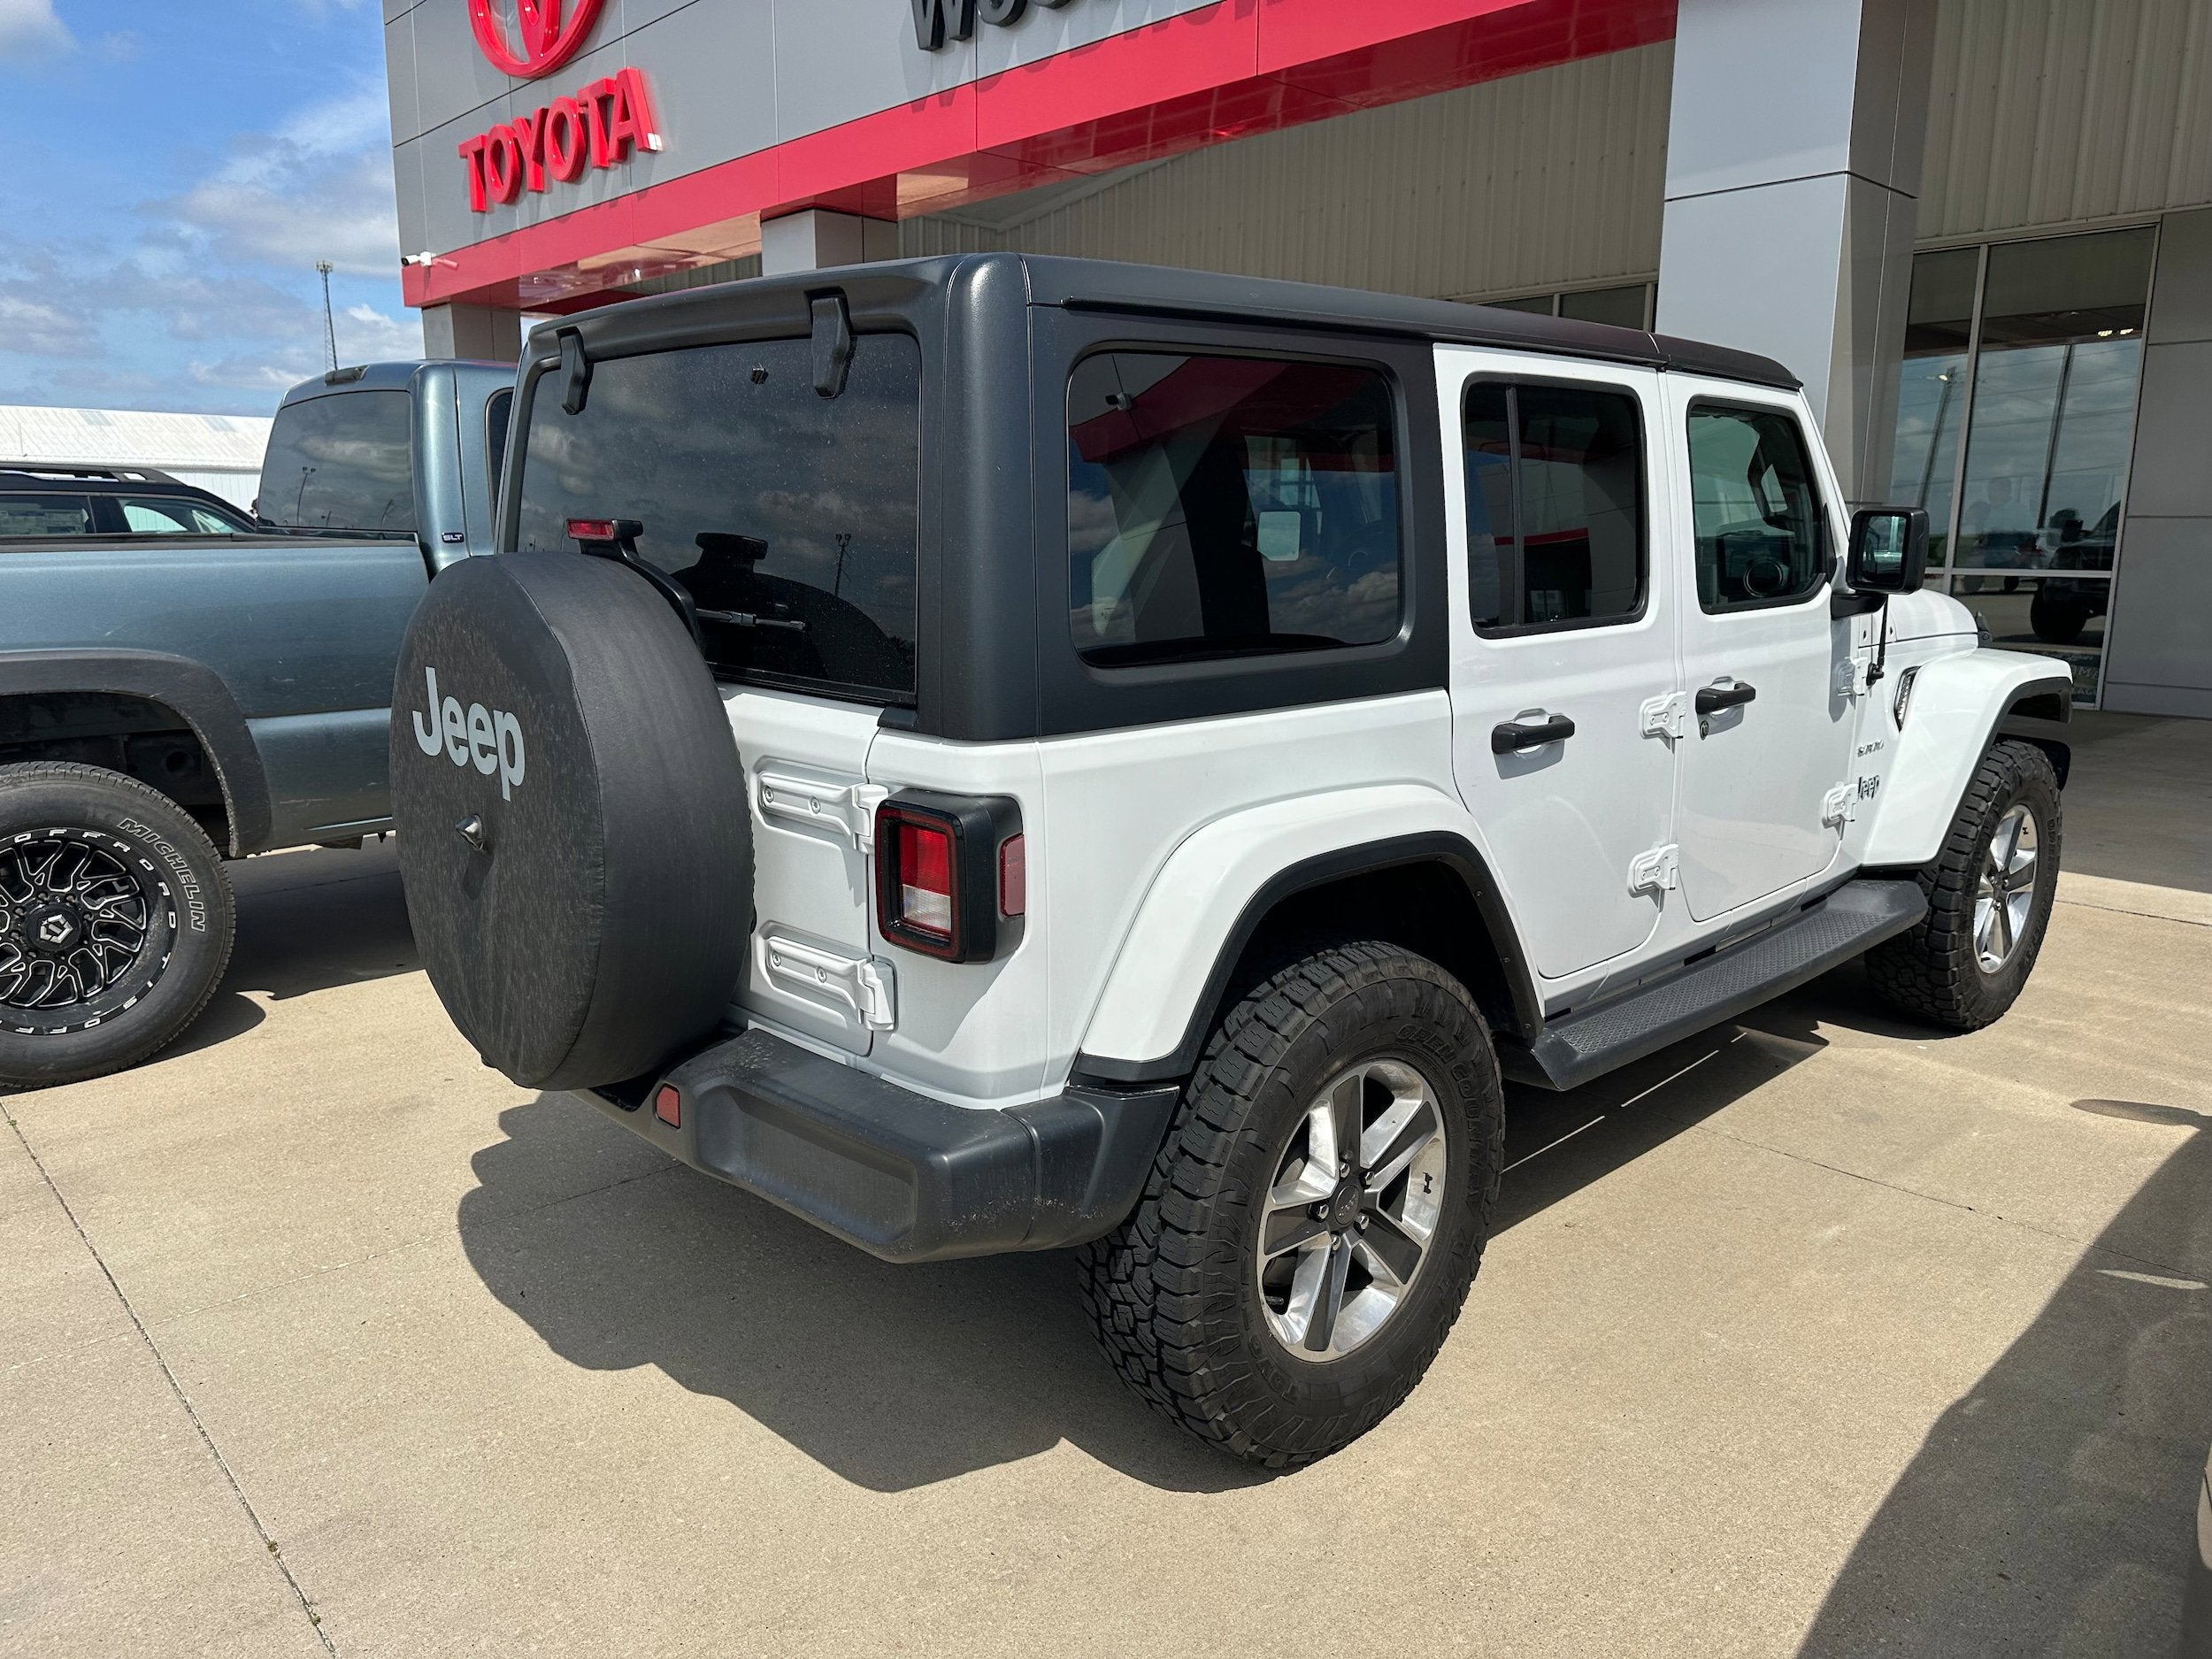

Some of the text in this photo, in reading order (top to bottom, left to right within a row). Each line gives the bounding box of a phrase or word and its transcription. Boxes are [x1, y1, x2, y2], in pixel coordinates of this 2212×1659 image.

[457, 66, 662, 213] TOYOTA
[442, 533, 463, 542] SLT
[411, 666, 526, 802] Jeep
[1858, 775, 1880, 801] Jeep
[117, 818, 207, 932] MICHELIN
[1395, 1023, 1457, 1064] OPEN
